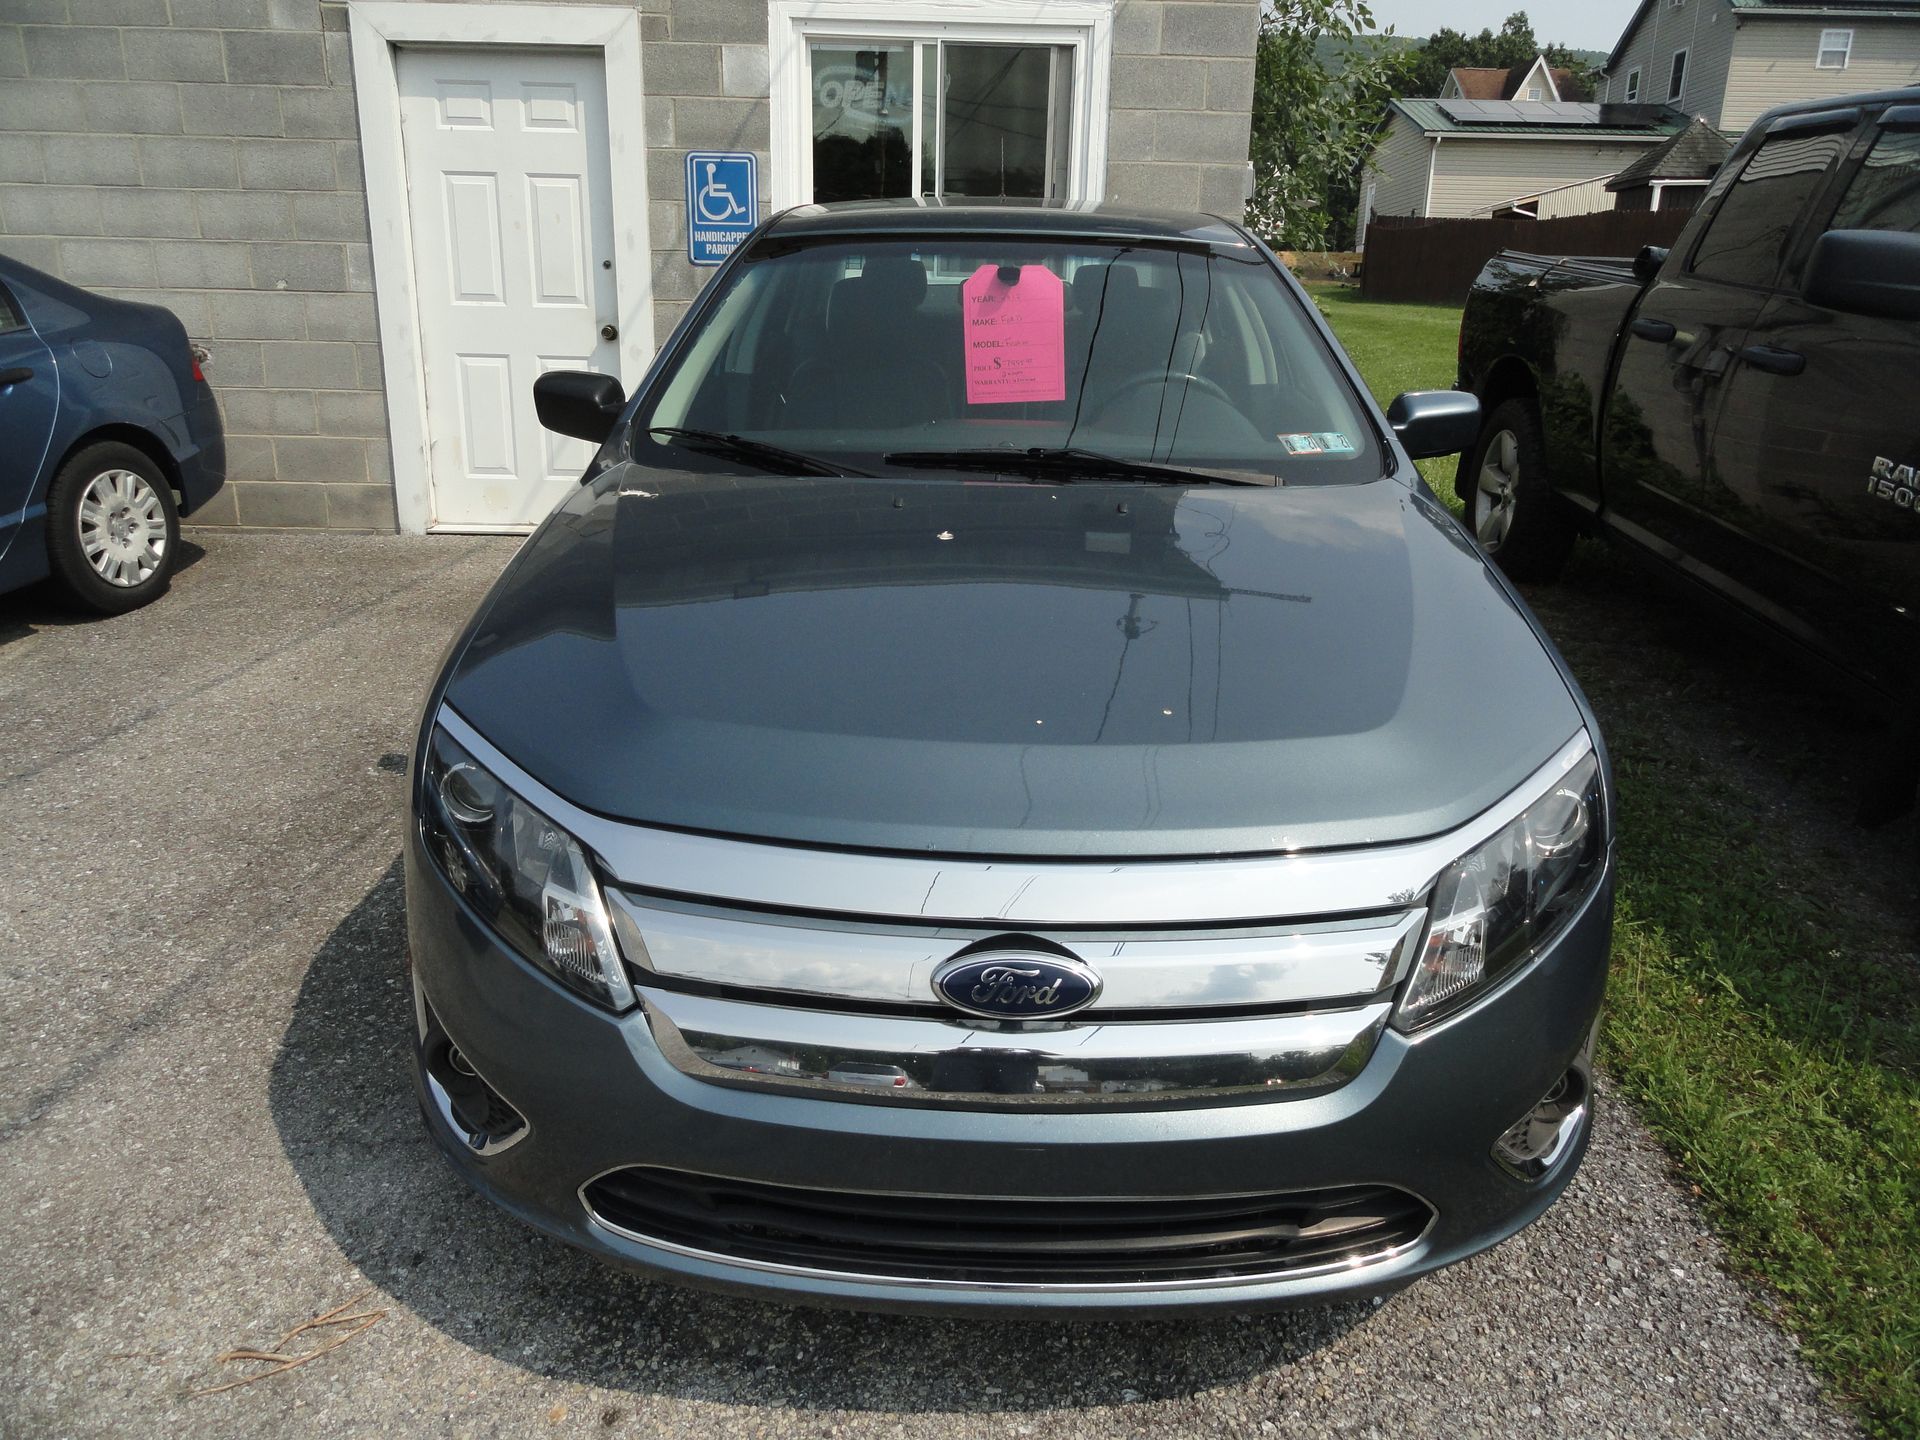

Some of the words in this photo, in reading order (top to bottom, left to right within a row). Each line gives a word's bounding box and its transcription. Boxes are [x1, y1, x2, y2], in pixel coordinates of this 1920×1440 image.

[695, 231, 751, 242] HANDICAPPE
[1872, 455, 1920, 490] RA
[971, 966, 1063, 1005] Ford
